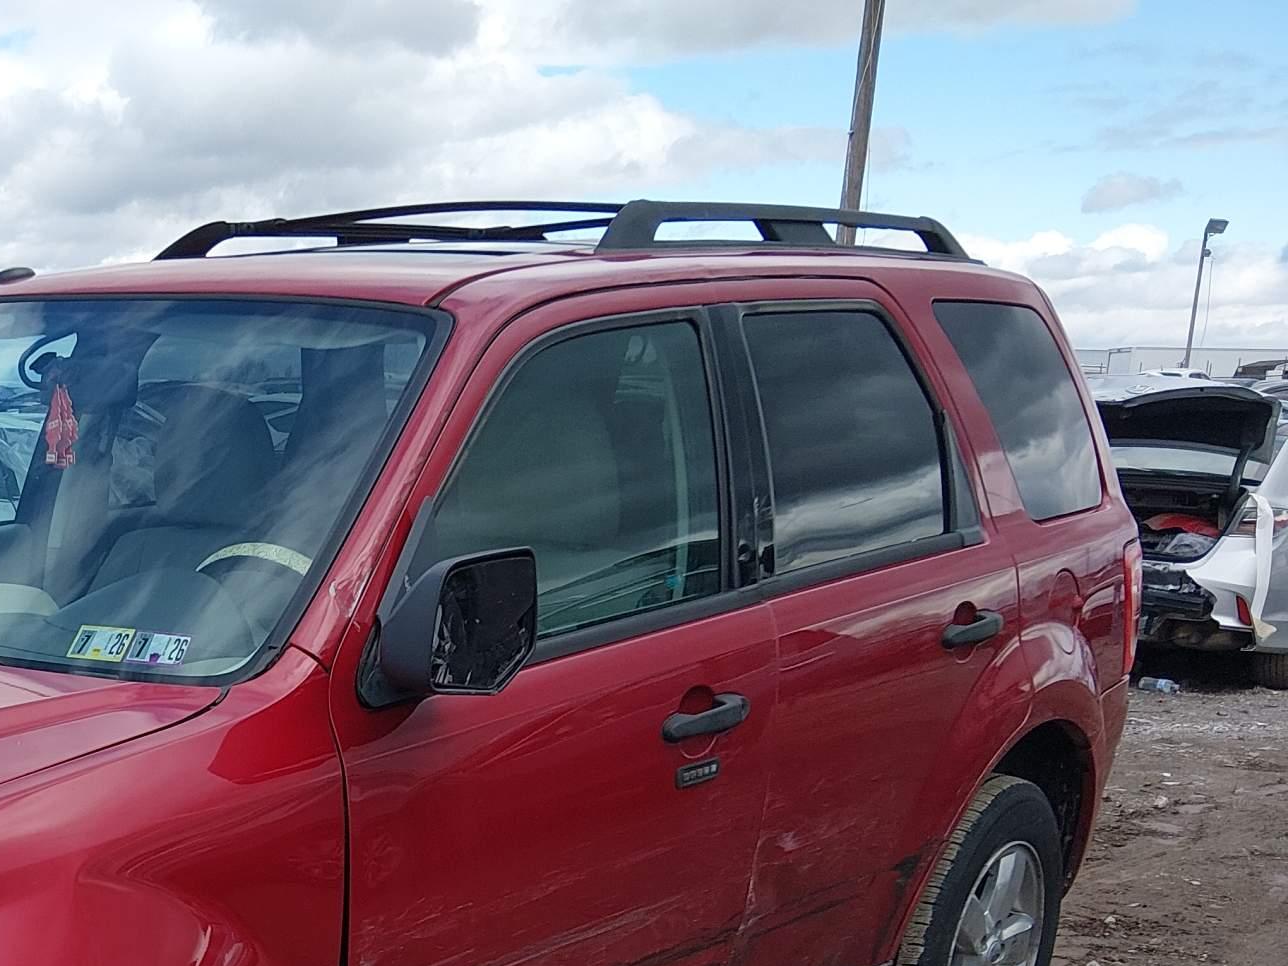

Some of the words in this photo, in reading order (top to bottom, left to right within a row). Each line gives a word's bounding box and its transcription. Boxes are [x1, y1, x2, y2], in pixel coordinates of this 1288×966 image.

[77, 634, 92, 654] 7
[108, 633, 130, 655] 26
[134, 637, 149, 659] 7
[167, 638, 189, 661] 26
